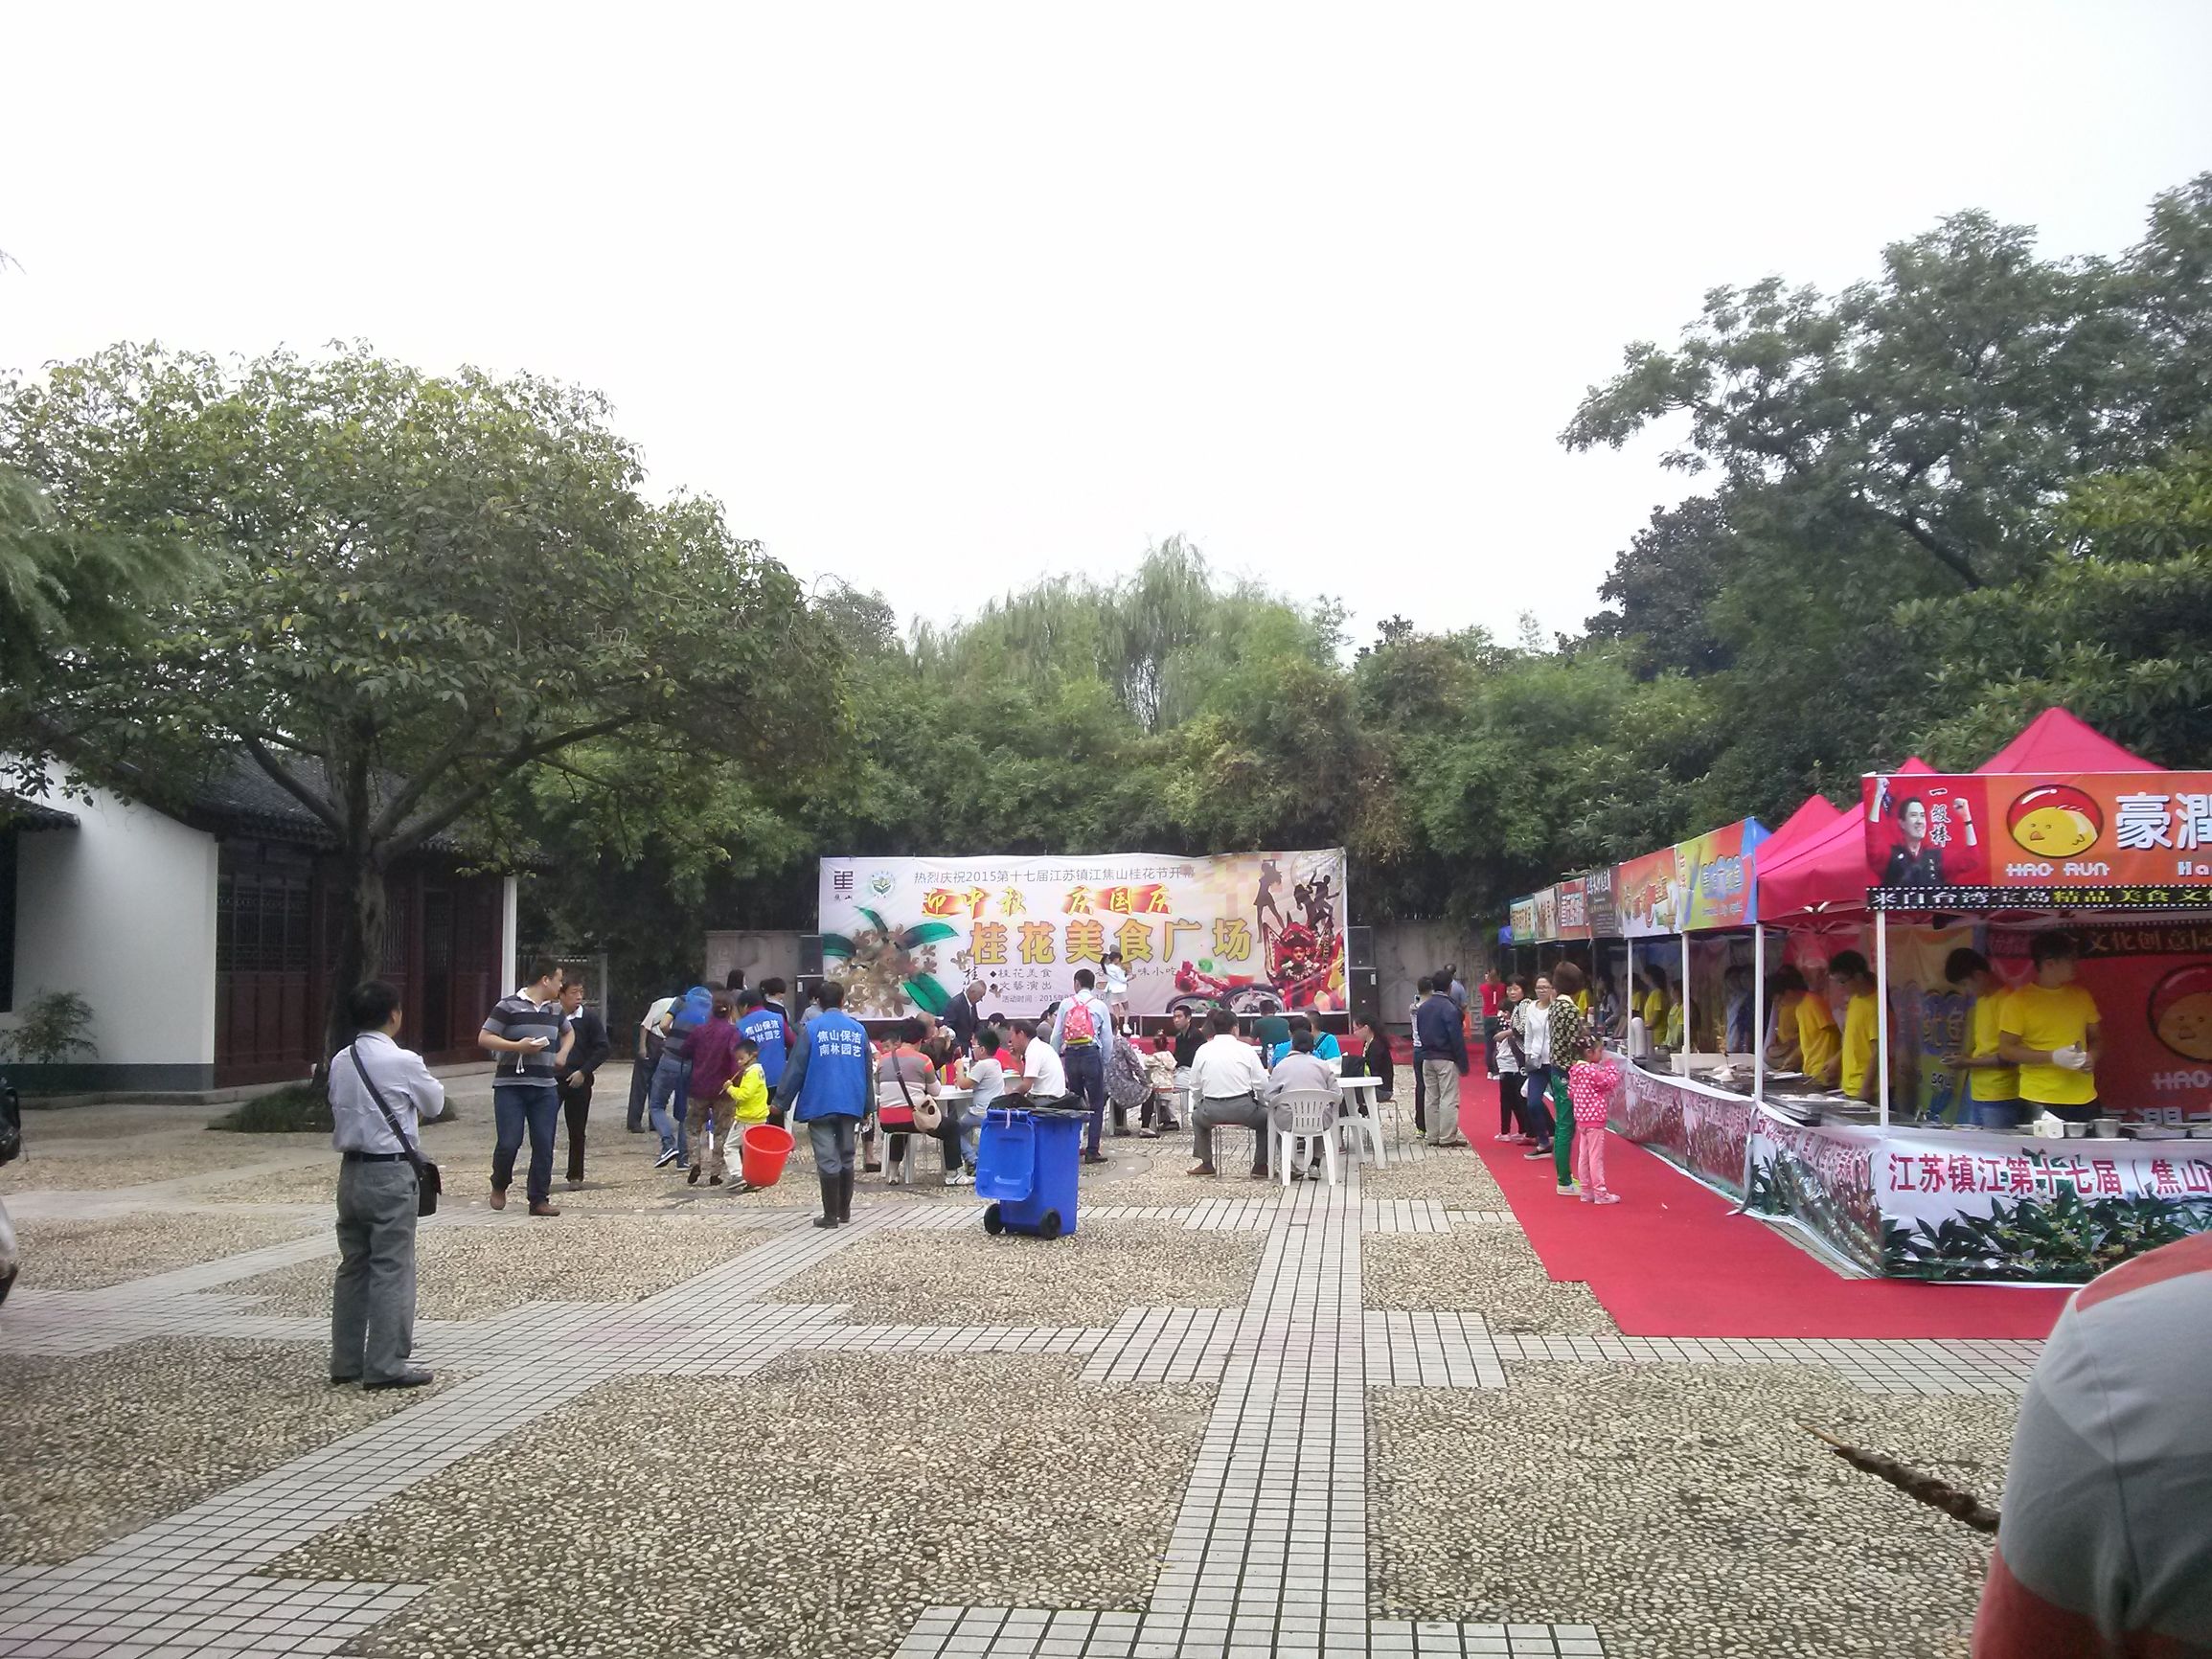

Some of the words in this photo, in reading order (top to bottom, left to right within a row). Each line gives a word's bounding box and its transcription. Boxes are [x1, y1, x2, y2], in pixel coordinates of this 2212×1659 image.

[969, 918, 1252, 965] 桂花美食广场
[998, 967, 1052, 979] 桂花美食
[817, 1030, 861, 1044] 焦山保洁
[819, 1043, 861, 1057] 南林园艺
[1888, 1151, 2212, 1195] 江苏镇江第十七届（焦山
